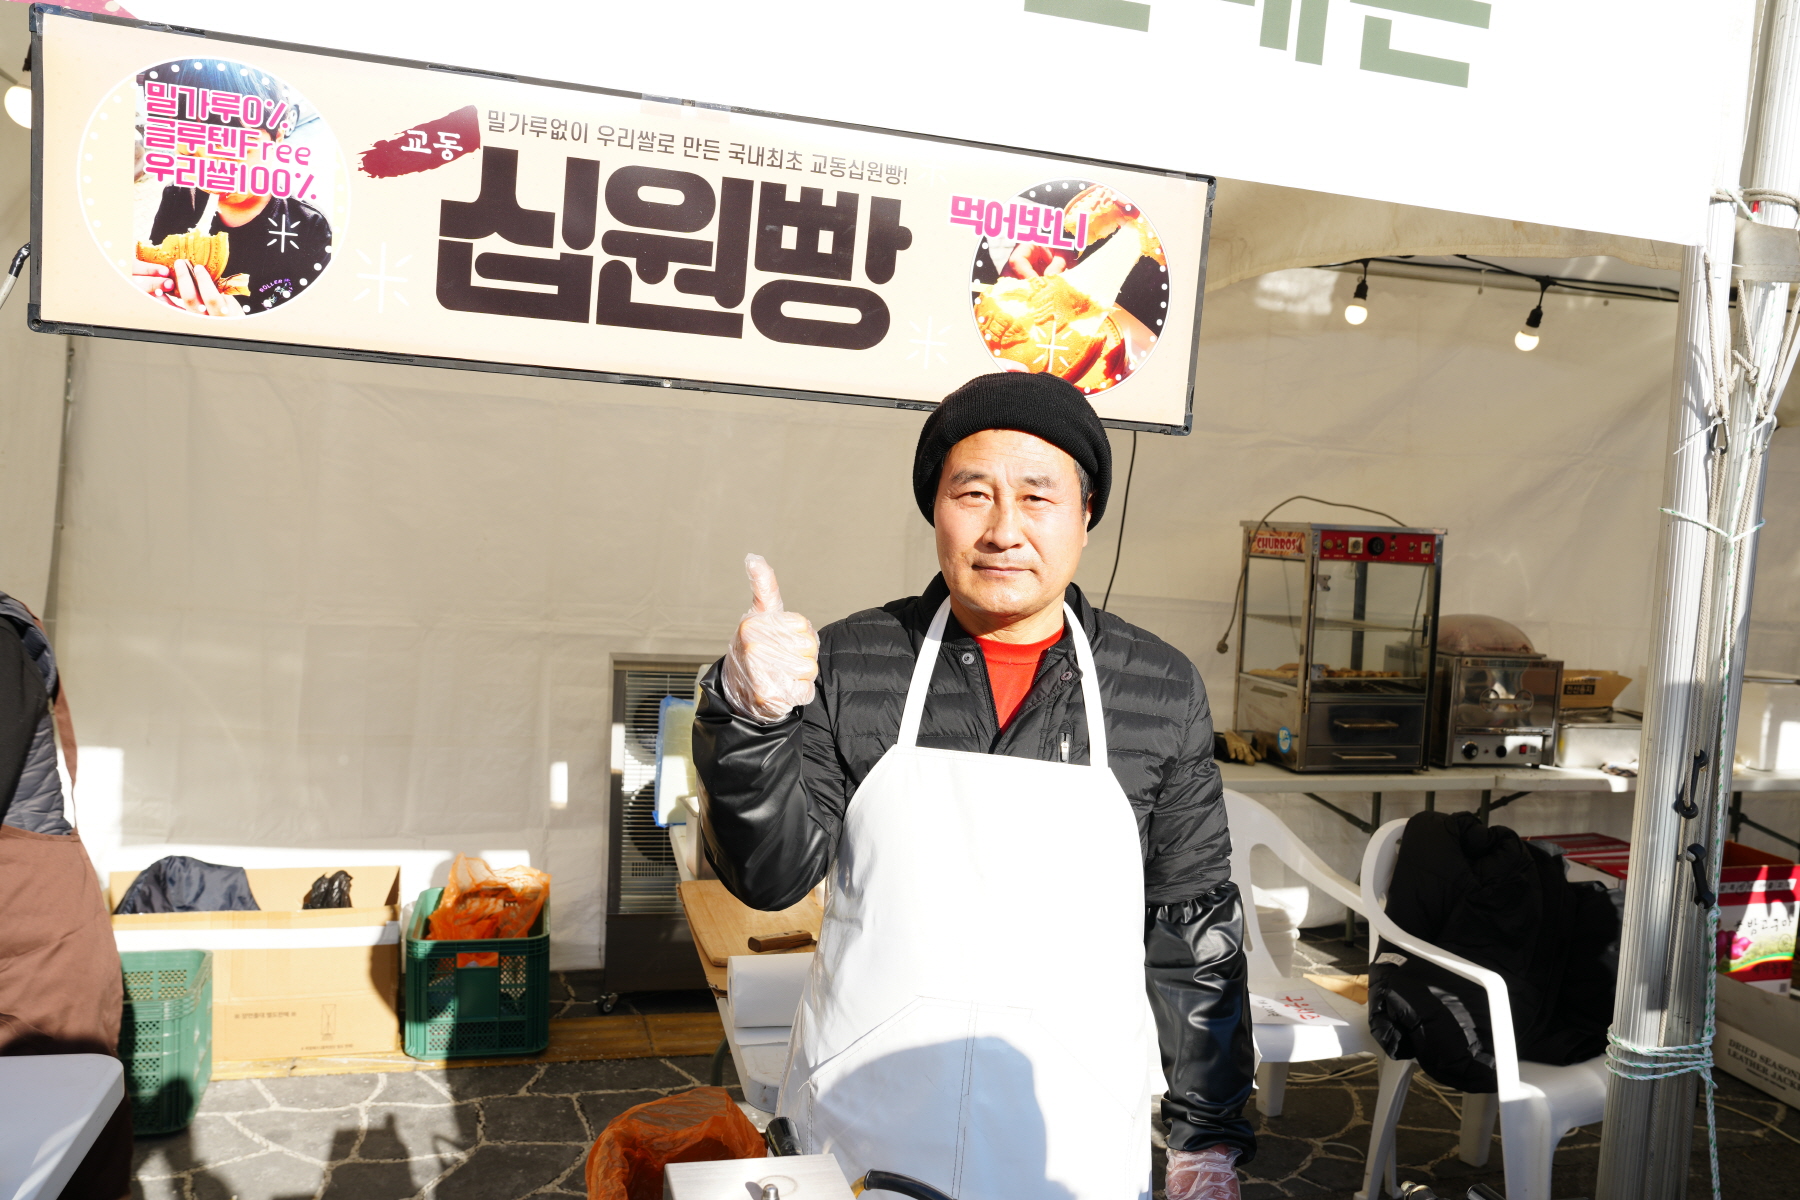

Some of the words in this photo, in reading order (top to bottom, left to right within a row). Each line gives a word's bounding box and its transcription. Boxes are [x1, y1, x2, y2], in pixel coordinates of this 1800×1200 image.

[146, 82, 289, 129] 밀가루0%
[146, 117, 311, 166] 글루텐Free
[400, 129, 464, 161] 교동
[488, 109, 589, 144] 밀가루없이
[596, 123, 676, 155] 우리쌀로
[683, 135, 721, 162] 만든
[728, 142, 804, 172] 국내최초
[810, 153, 908, 185] 교동십원빵!
[145, 153, 317, 200] 우리쌀100%
[436, 145, 913, 351] 십원빵
[1257, 537, 1297, 550] CHURROS
[1727, 1048, 1769, 1075] LEATHER
[1729, 1039, 1758, 1059] DRIED
